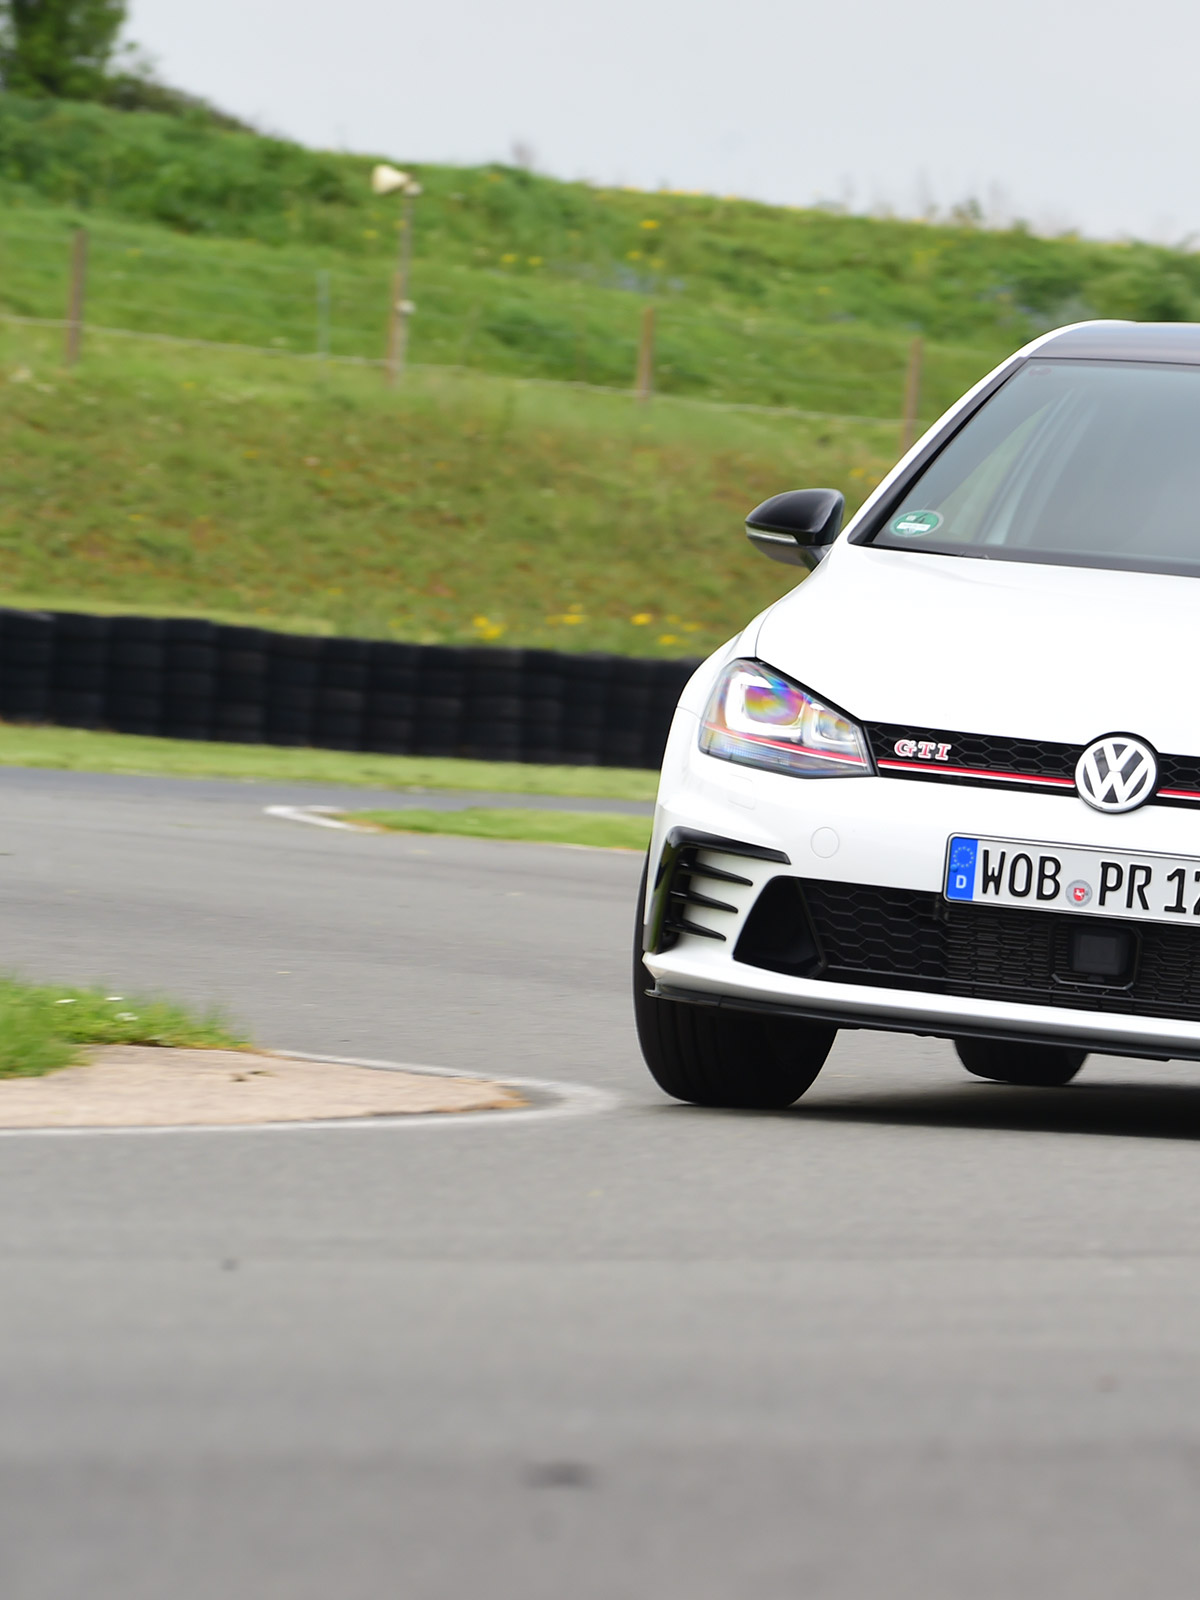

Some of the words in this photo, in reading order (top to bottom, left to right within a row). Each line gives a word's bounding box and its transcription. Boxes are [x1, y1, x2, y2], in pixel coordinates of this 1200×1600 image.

[894, 739, 952, 761] GTI
[1076, 738, 1156, 810] VW
[956, 874, 966, 889] D
[982, 849, 1061, 901] WOB
[1099, 861, 1152, 911] PR
